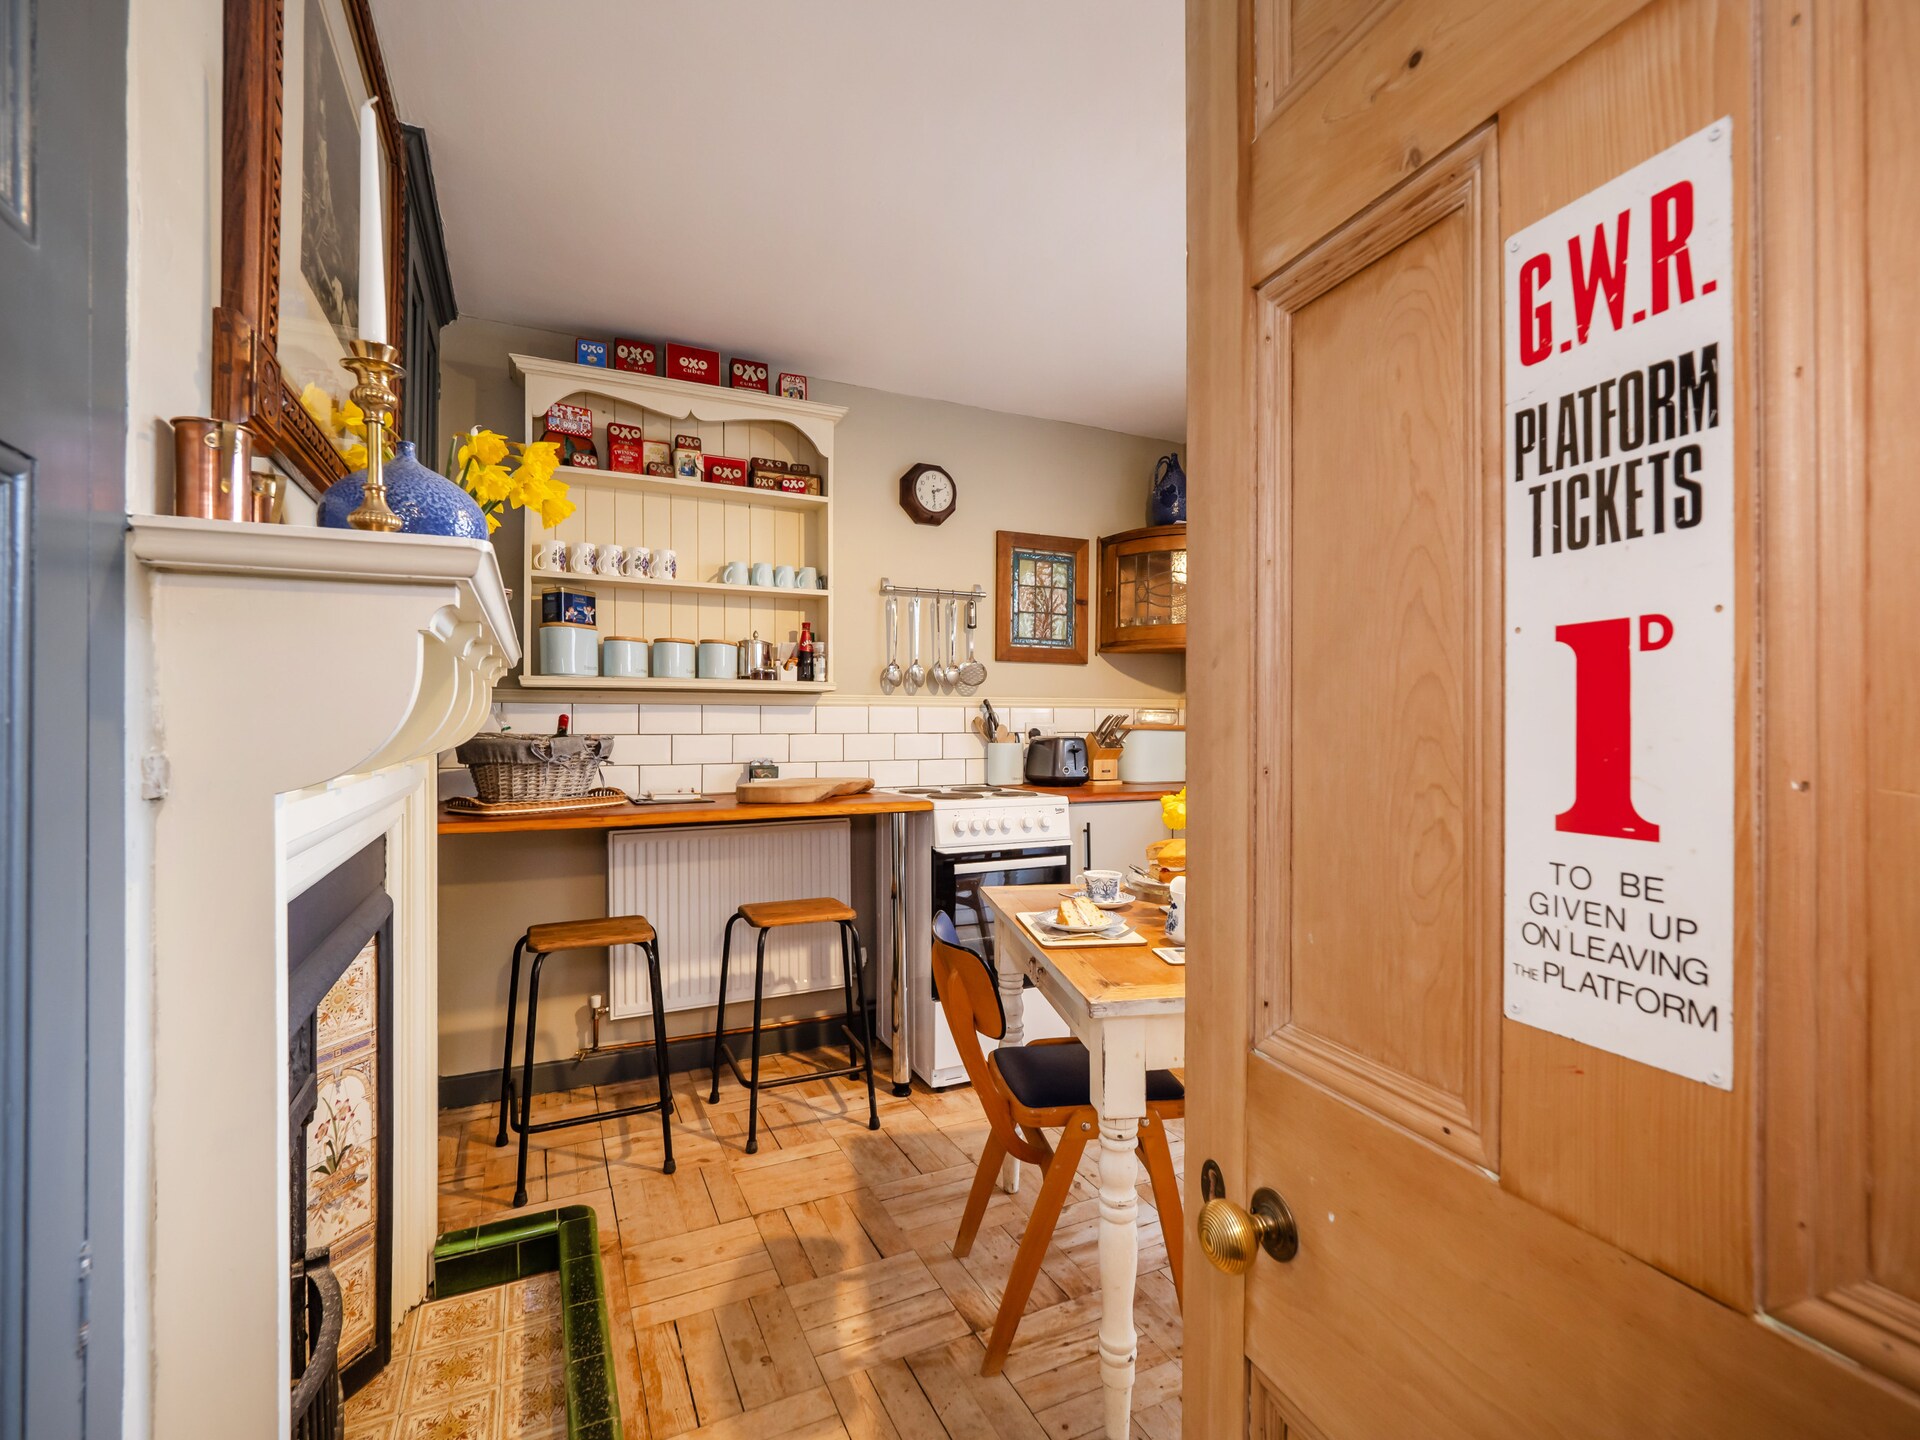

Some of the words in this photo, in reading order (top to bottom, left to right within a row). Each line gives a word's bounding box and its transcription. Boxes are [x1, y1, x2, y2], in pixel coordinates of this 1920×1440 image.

[1519, 180, 1717, 367] G.W.R.
[581, 343, 604, 354] OXO
[617, 345, 654, 365] OXO
[679, 356, 708, 370] OXO
[683, 367, 705, 376] cubes
[733, 363, 767, 382] OXO
[1515, 341, 1719, 483] PLATFORM
[610, 425, 641, 440] OXO
[678, 436, 700, 447] OXO
[574, 454, 598, 466] OXO
[758, 459, 782, 468] OXO
[649, 462, 674, 474] OXO
[713, 466, 742, 480] OXO
[755, 477, 774, 487] OXO
[782, 479, 805, 489] OXO
[1528, 443, 1703, 558] TICKETS
[1549, 862, 1592, 890] TO
[1620, 872, 1664, 904] BE
[1529, 891, 1626, 932] GIVEN
[1649, 912, 1698, 943] UP
[1522, 921, 1560, 952] ON
[1570, 931, 1709, 987] LEAVING
[1513, 962, 1539, 981] THE
[1543, 961, 1718, 1032] PLATFORM
